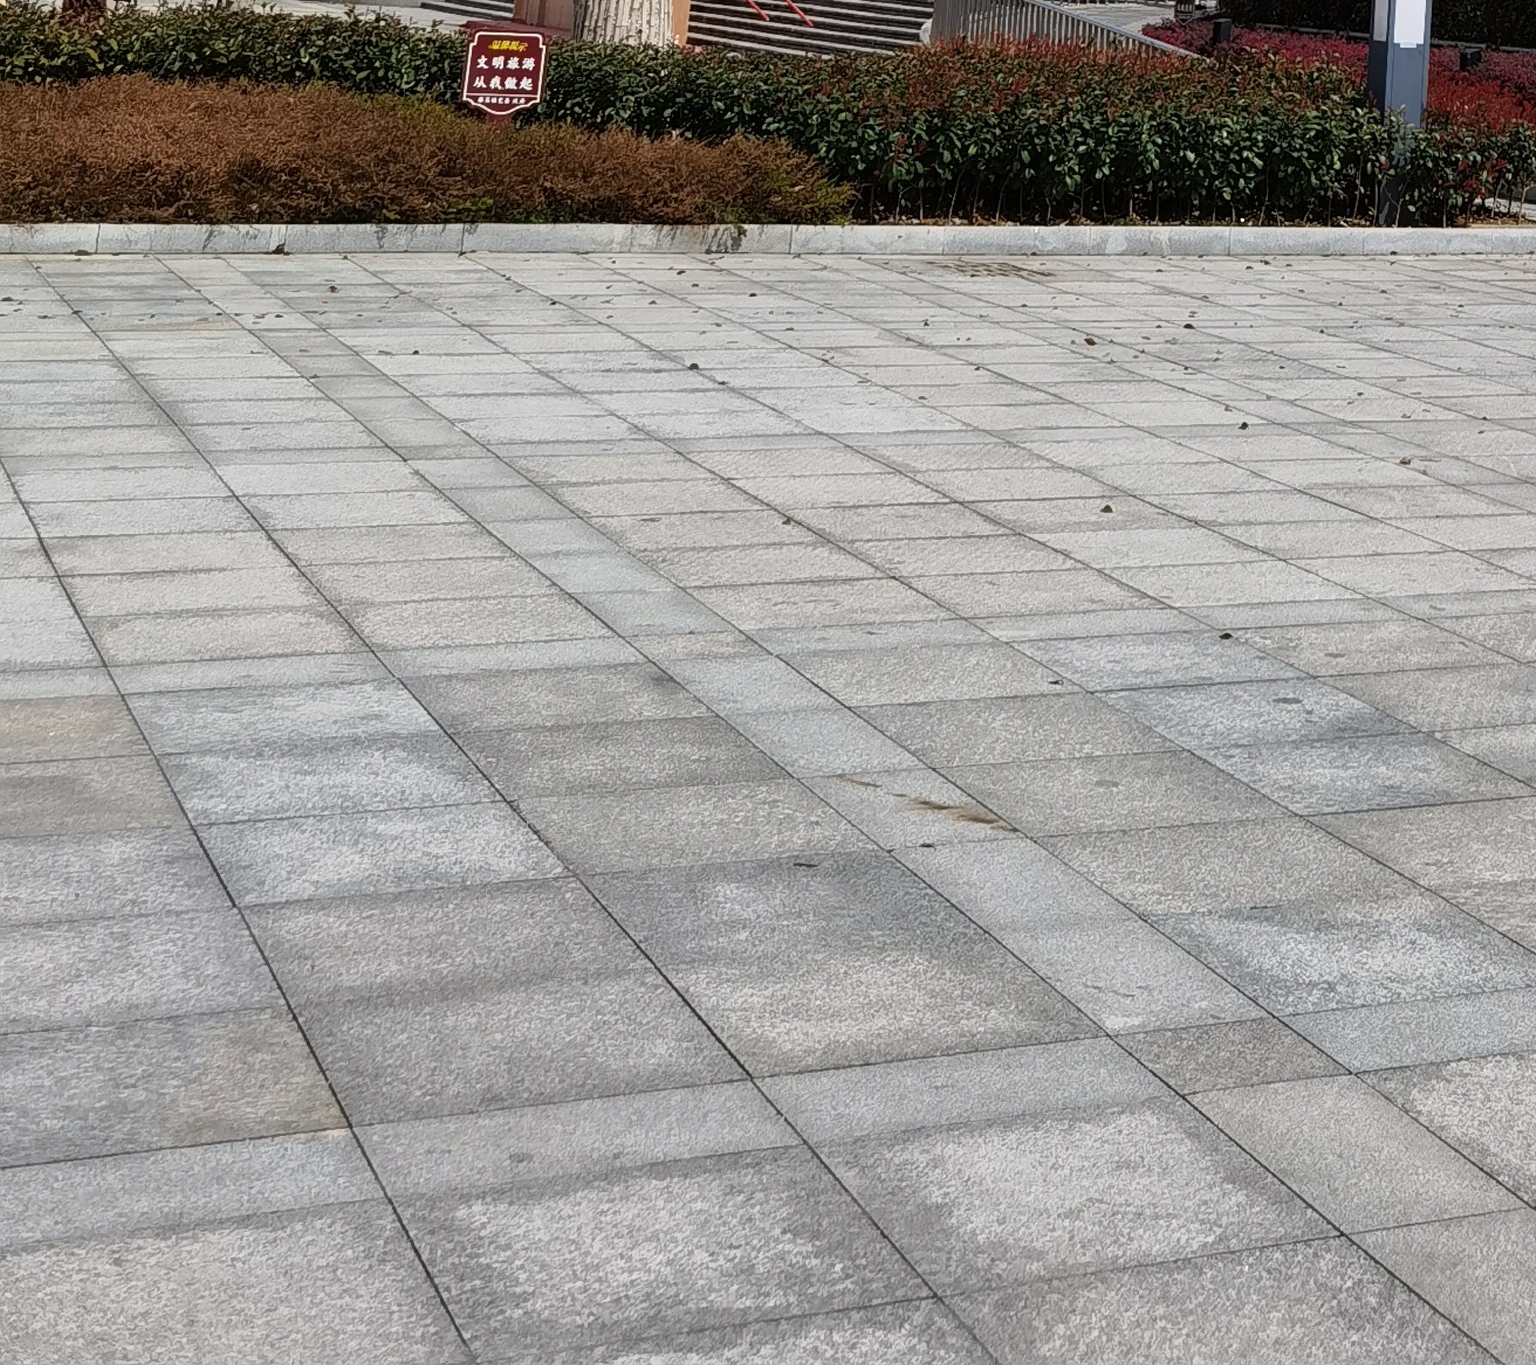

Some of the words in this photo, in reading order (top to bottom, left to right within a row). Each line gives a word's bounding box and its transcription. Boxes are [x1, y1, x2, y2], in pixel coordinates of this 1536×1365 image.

[476, 55, 535, 71] 文明旅游
[473, 75, 533, 90] 从我做起
